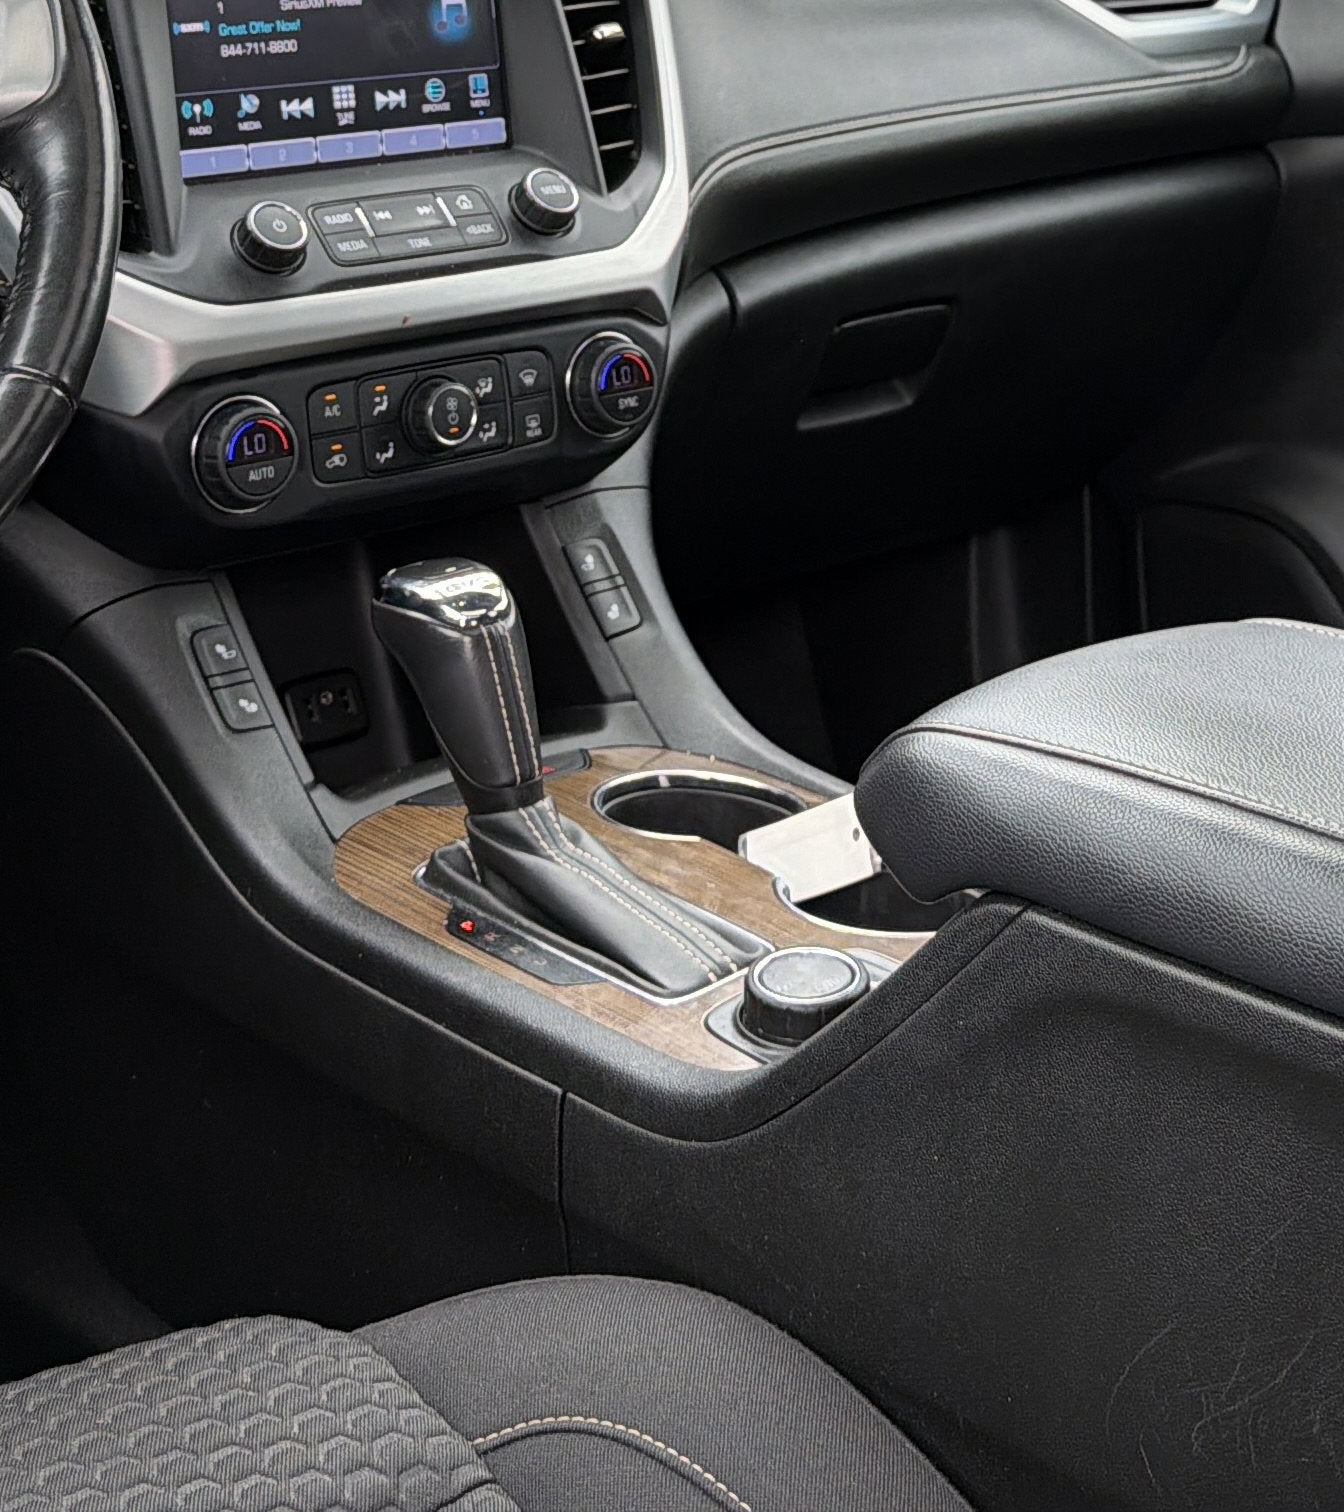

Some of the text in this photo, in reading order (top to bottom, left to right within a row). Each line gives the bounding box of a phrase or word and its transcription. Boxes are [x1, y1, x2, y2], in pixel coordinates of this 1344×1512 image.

[323, 212, 354, 225] RADIO
[337, 239, 368, 252] MEDIA
[617, 394, 639, 410] SYNC
[324, 404, 342, 418] A/C
[248, 464, 275, 482] AUTO
